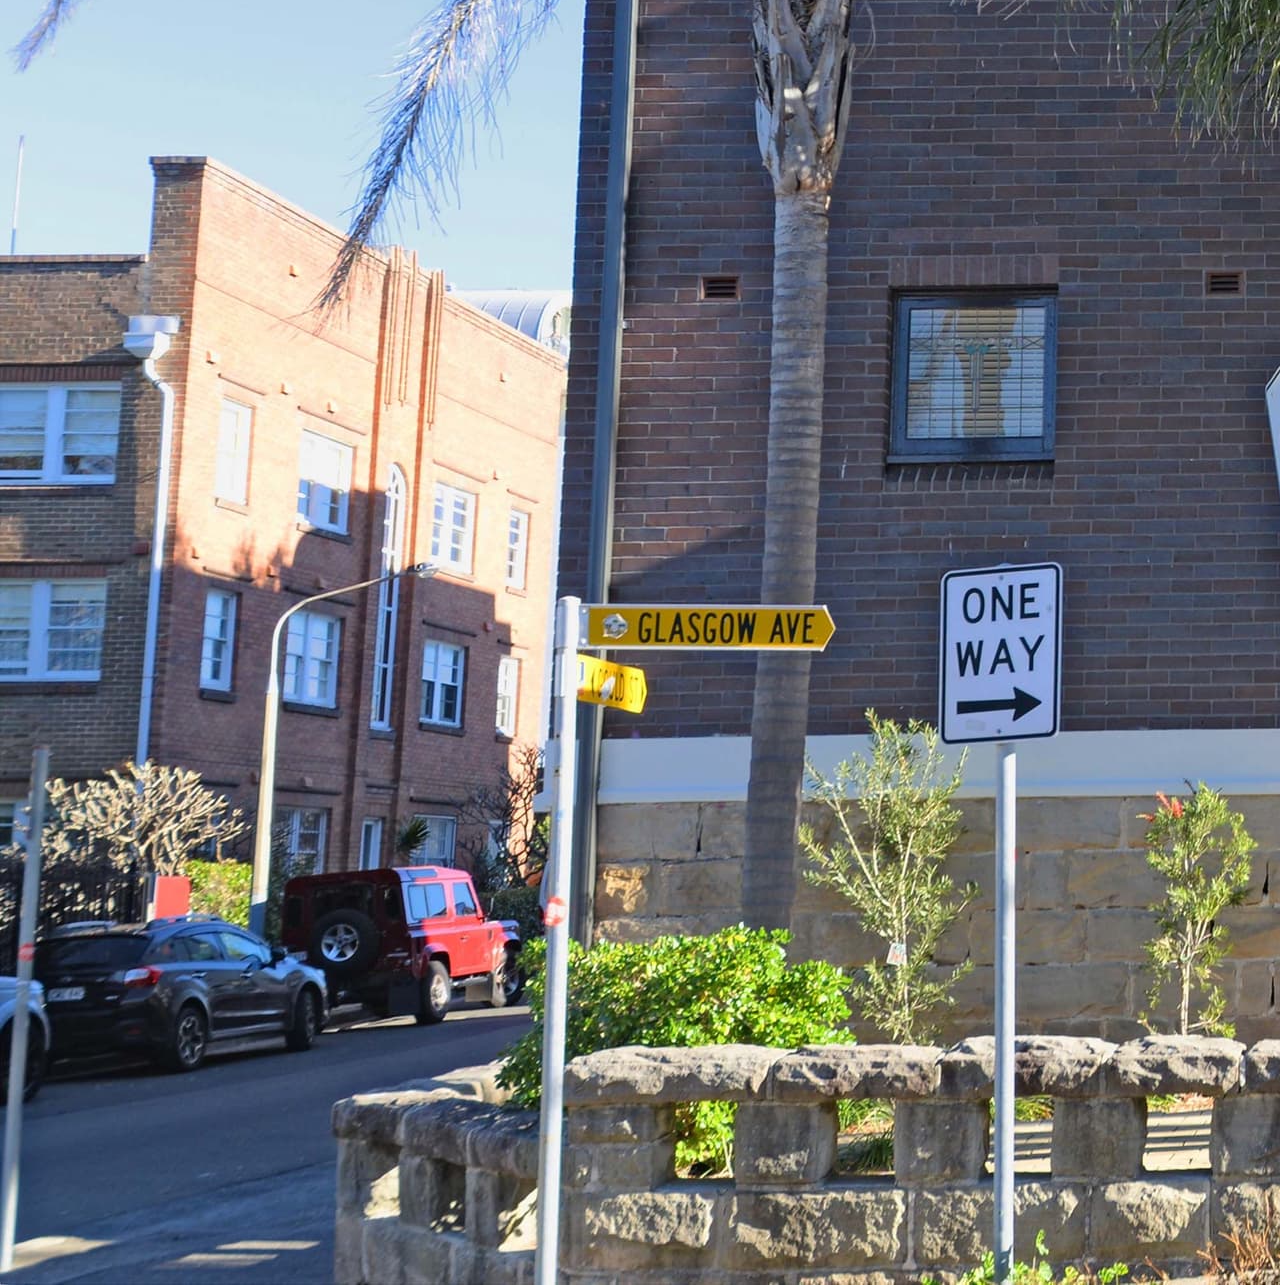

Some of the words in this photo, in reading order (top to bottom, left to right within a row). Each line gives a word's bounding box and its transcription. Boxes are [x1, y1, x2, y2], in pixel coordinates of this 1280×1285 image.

[962, 583, 1040, 624] ONE
[638, 612, 757, 644] GLASGOW
[769, 612, 815, 644] AVE
[956, 635, 1045, 677] WAY
